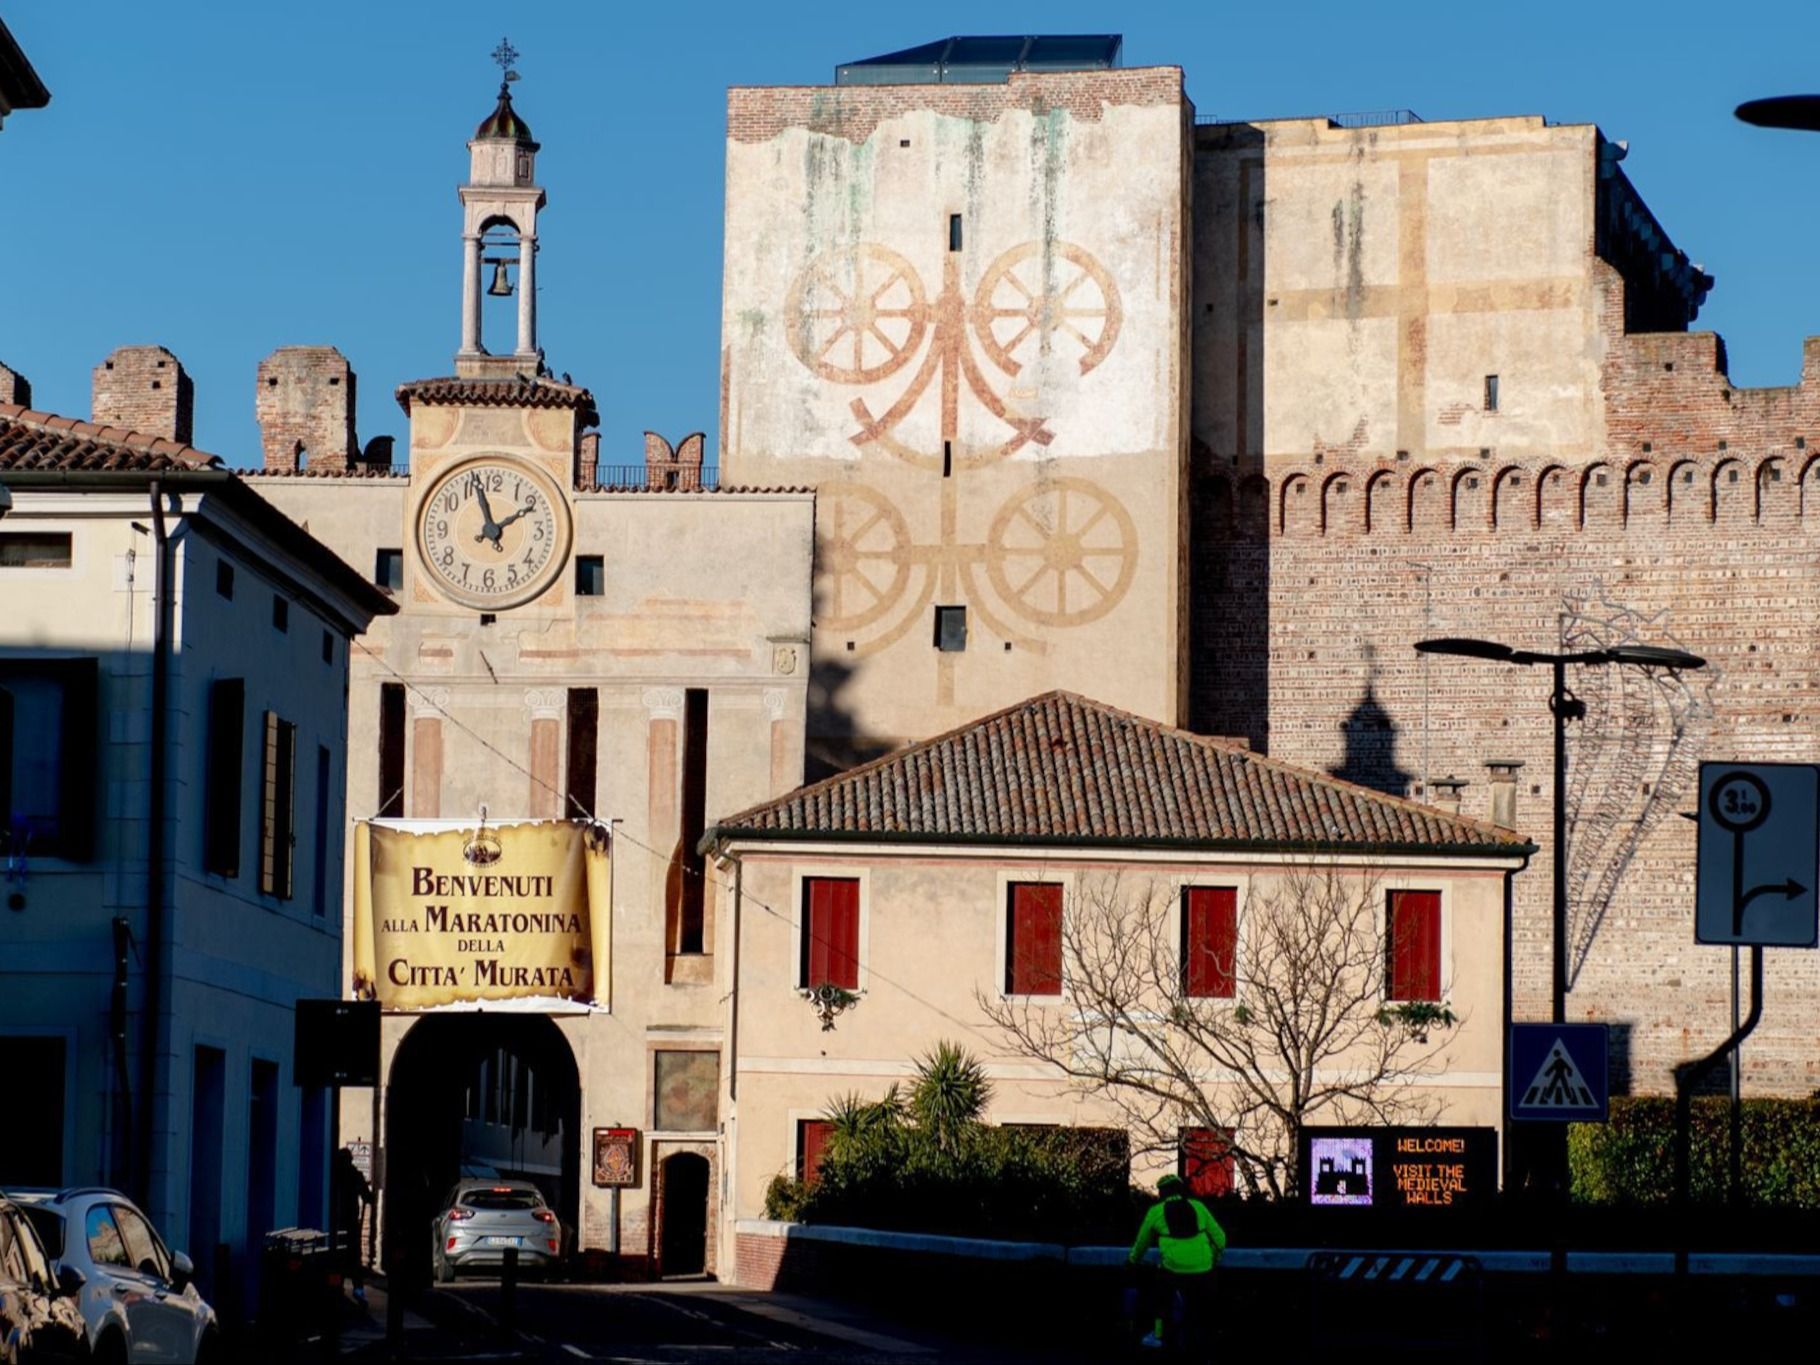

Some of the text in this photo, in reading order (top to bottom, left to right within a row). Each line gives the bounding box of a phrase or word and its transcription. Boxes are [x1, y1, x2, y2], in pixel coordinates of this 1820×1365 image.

[486, 474, 503, 493] 12
[514, 482, 520, 501] 1
[444, 492, 459, 513] 10
[525, 494, 537, 513] 2
[436, 520, 448, 539] 9
[533, 521, 544, 541] 3
[443, 546, 454, 567] 8
[523, 547, 535, 569] 4
[461, 563, 470, 581] 7
[483, 568, 495, 588] 6
[507, 564, 518, 584] 5
[411, 866, 553, 897] BENVENUTI
[381, 905, 581, 933] ALLA MARATONINA
[457, 939, 505, 952] DELLA
[388, 958, 576, 987] CITTA' MURATA
[1397, 1138, 1465, 1153] WELCOME!
[1393, 1164, 1465, 1178] VISIT THE
[1397, 1178, 1468, 1191] MEDIEVAL
[1407, 1191, 1453, 1205] WALLS
